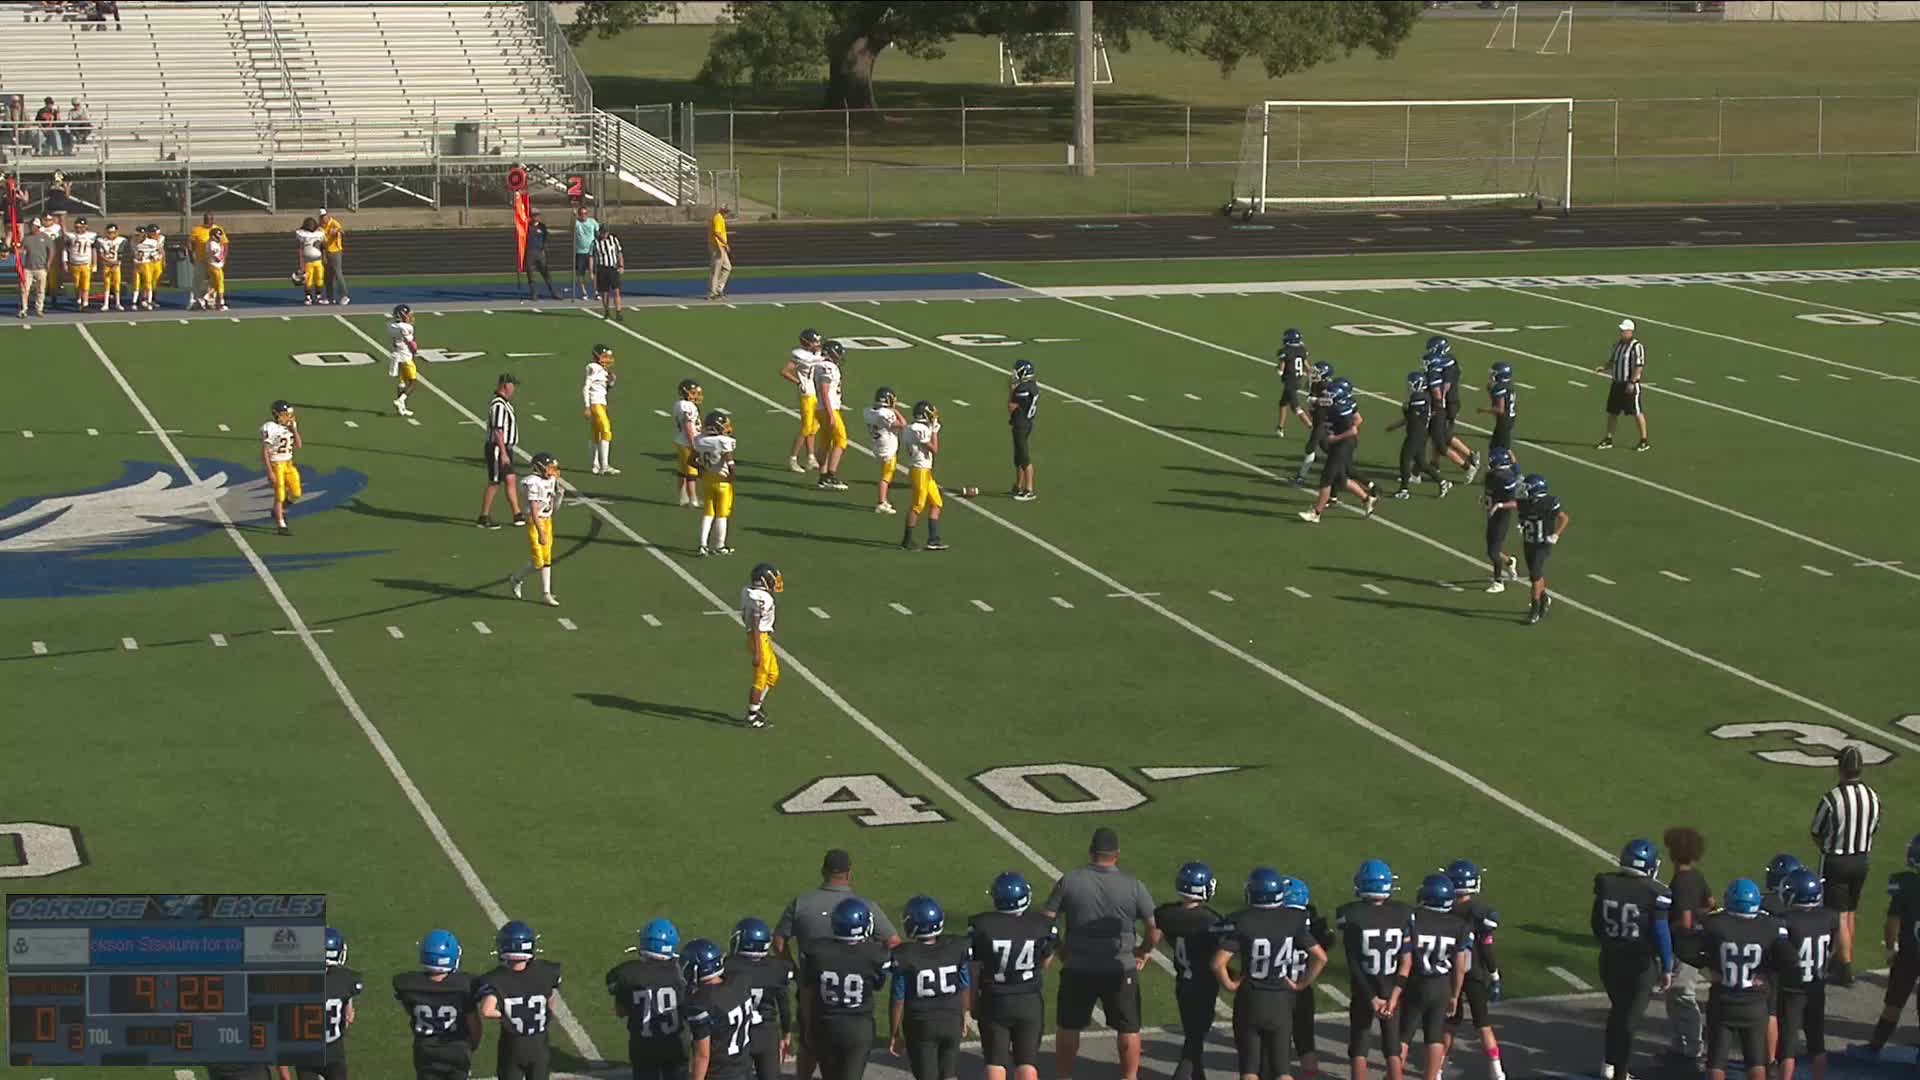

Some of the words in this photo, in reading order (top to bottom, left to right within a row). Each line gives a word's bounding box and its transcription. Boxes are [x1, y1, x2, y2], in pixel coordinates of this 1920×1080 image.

[568, 176, 583, 195] 2
[828, 333, 1026, 350] 30
[1329, 320, 1519, 337] 20
[1294, 357, 1304, 377] 9
[1524, 519, 1544, 543] 21
[992, 940, 1035, 981] 74
[1250, 936, 1293, 979] 84
[1362, 928, 1403, 975] 52
[1417, 934, 1456, 974] 75
[1720, 942, 1762, 989] 62
[325, 998, 345, 1044] 3
[503, 994, 547, 1034] 53
[634, 987, 677, 1036] 79
